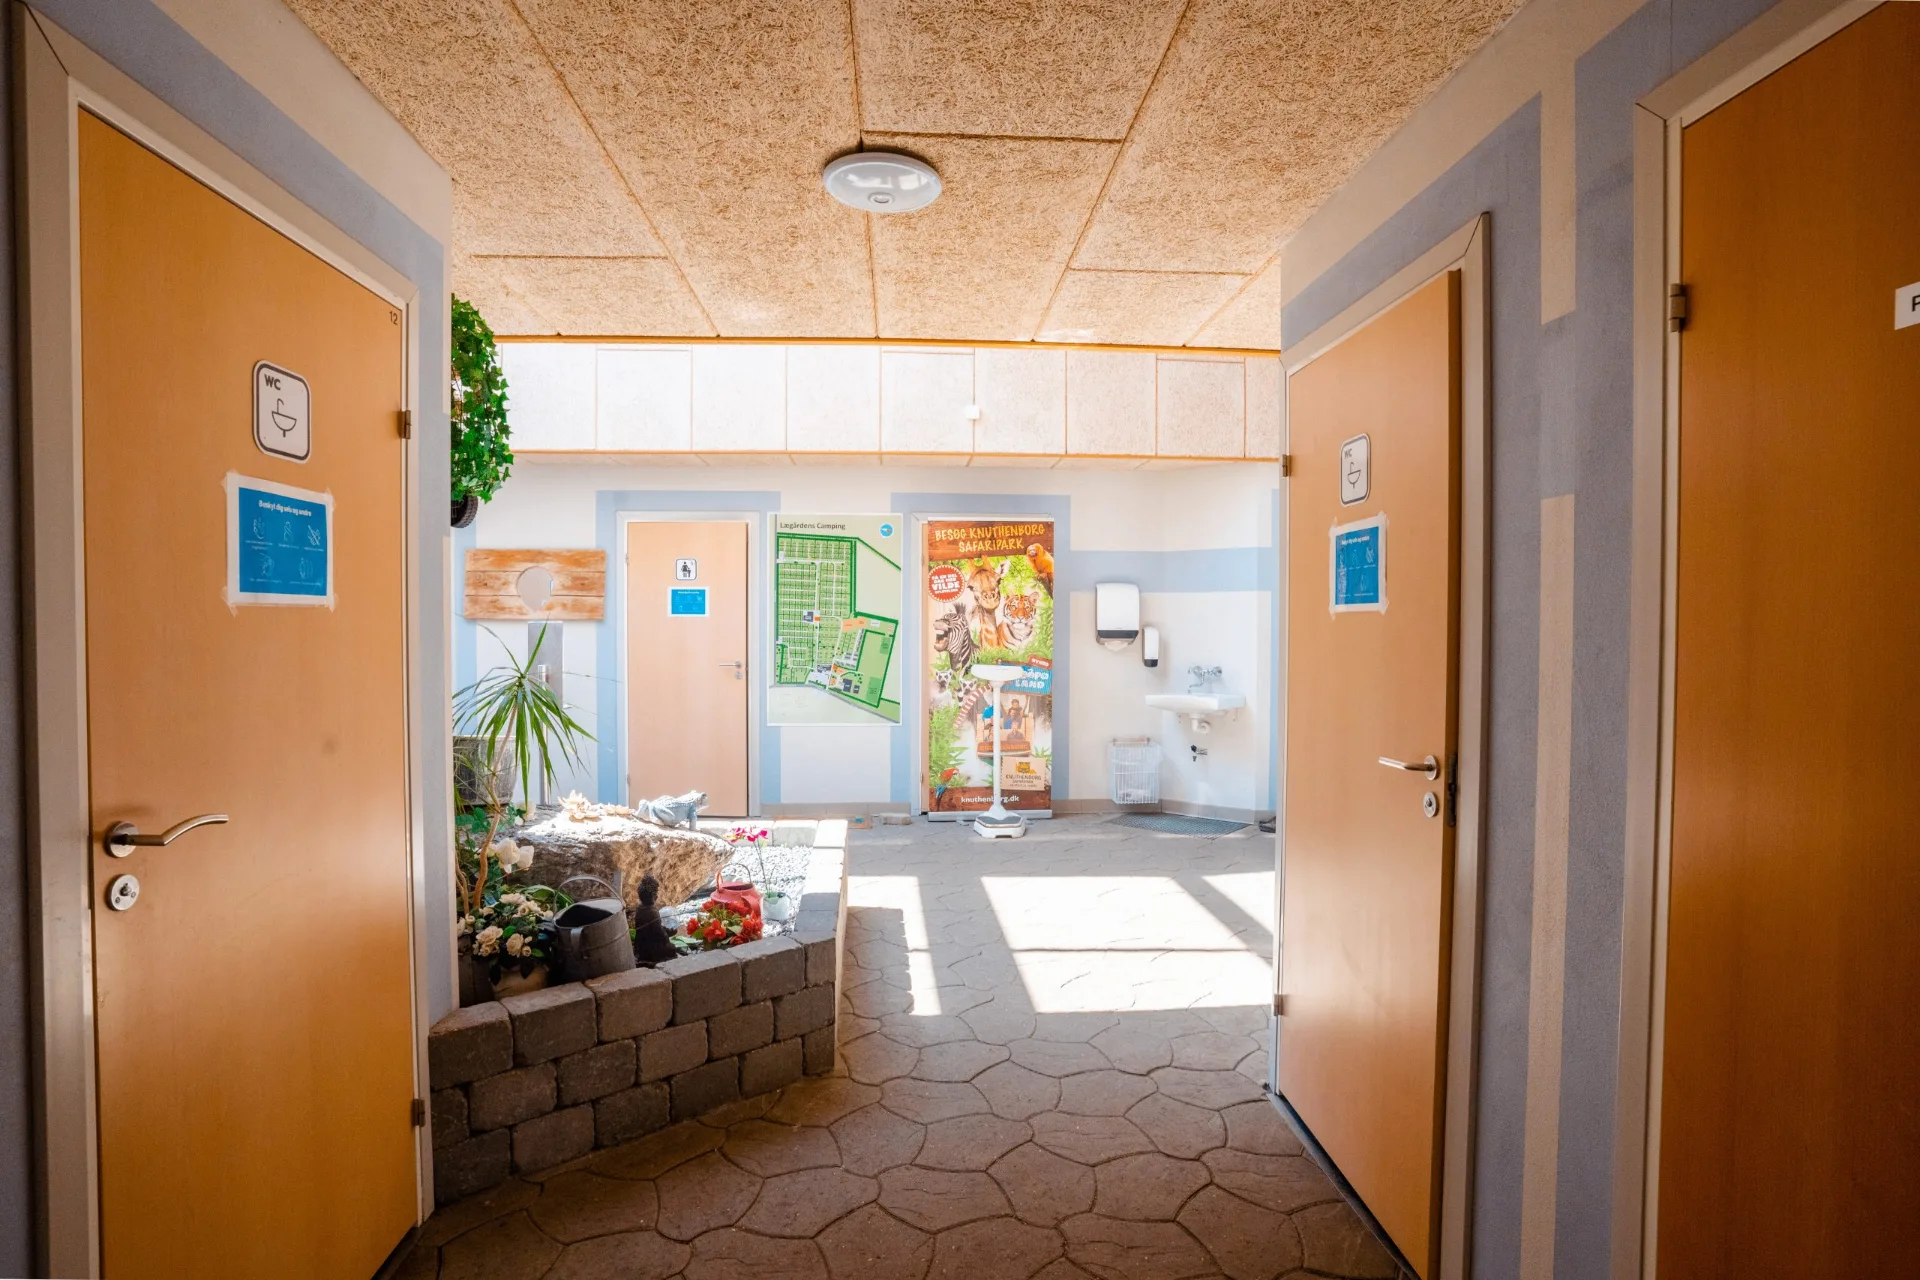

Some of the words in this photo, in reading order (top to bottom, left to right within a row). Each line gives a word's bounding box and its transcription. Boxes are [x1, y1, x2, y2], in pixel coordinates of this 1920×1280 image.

[389, 310, 399, 326] 12
[264, 373, 281, 391] WC
[1343, 448, 1353, 460] WC
[779, 522, 816, 530] Lægårdens
[817, 522, 846, 530] Camping
[935, 528, 967, 541] BESØG
[969, 524, 1046, 539] KNUTHENBORG
[958, 538, 1025, 553] SAFARIPARK
[931, 581, 960, 591] VILDE
[961, 795, 1020, 804] knuthenbrg.dk
